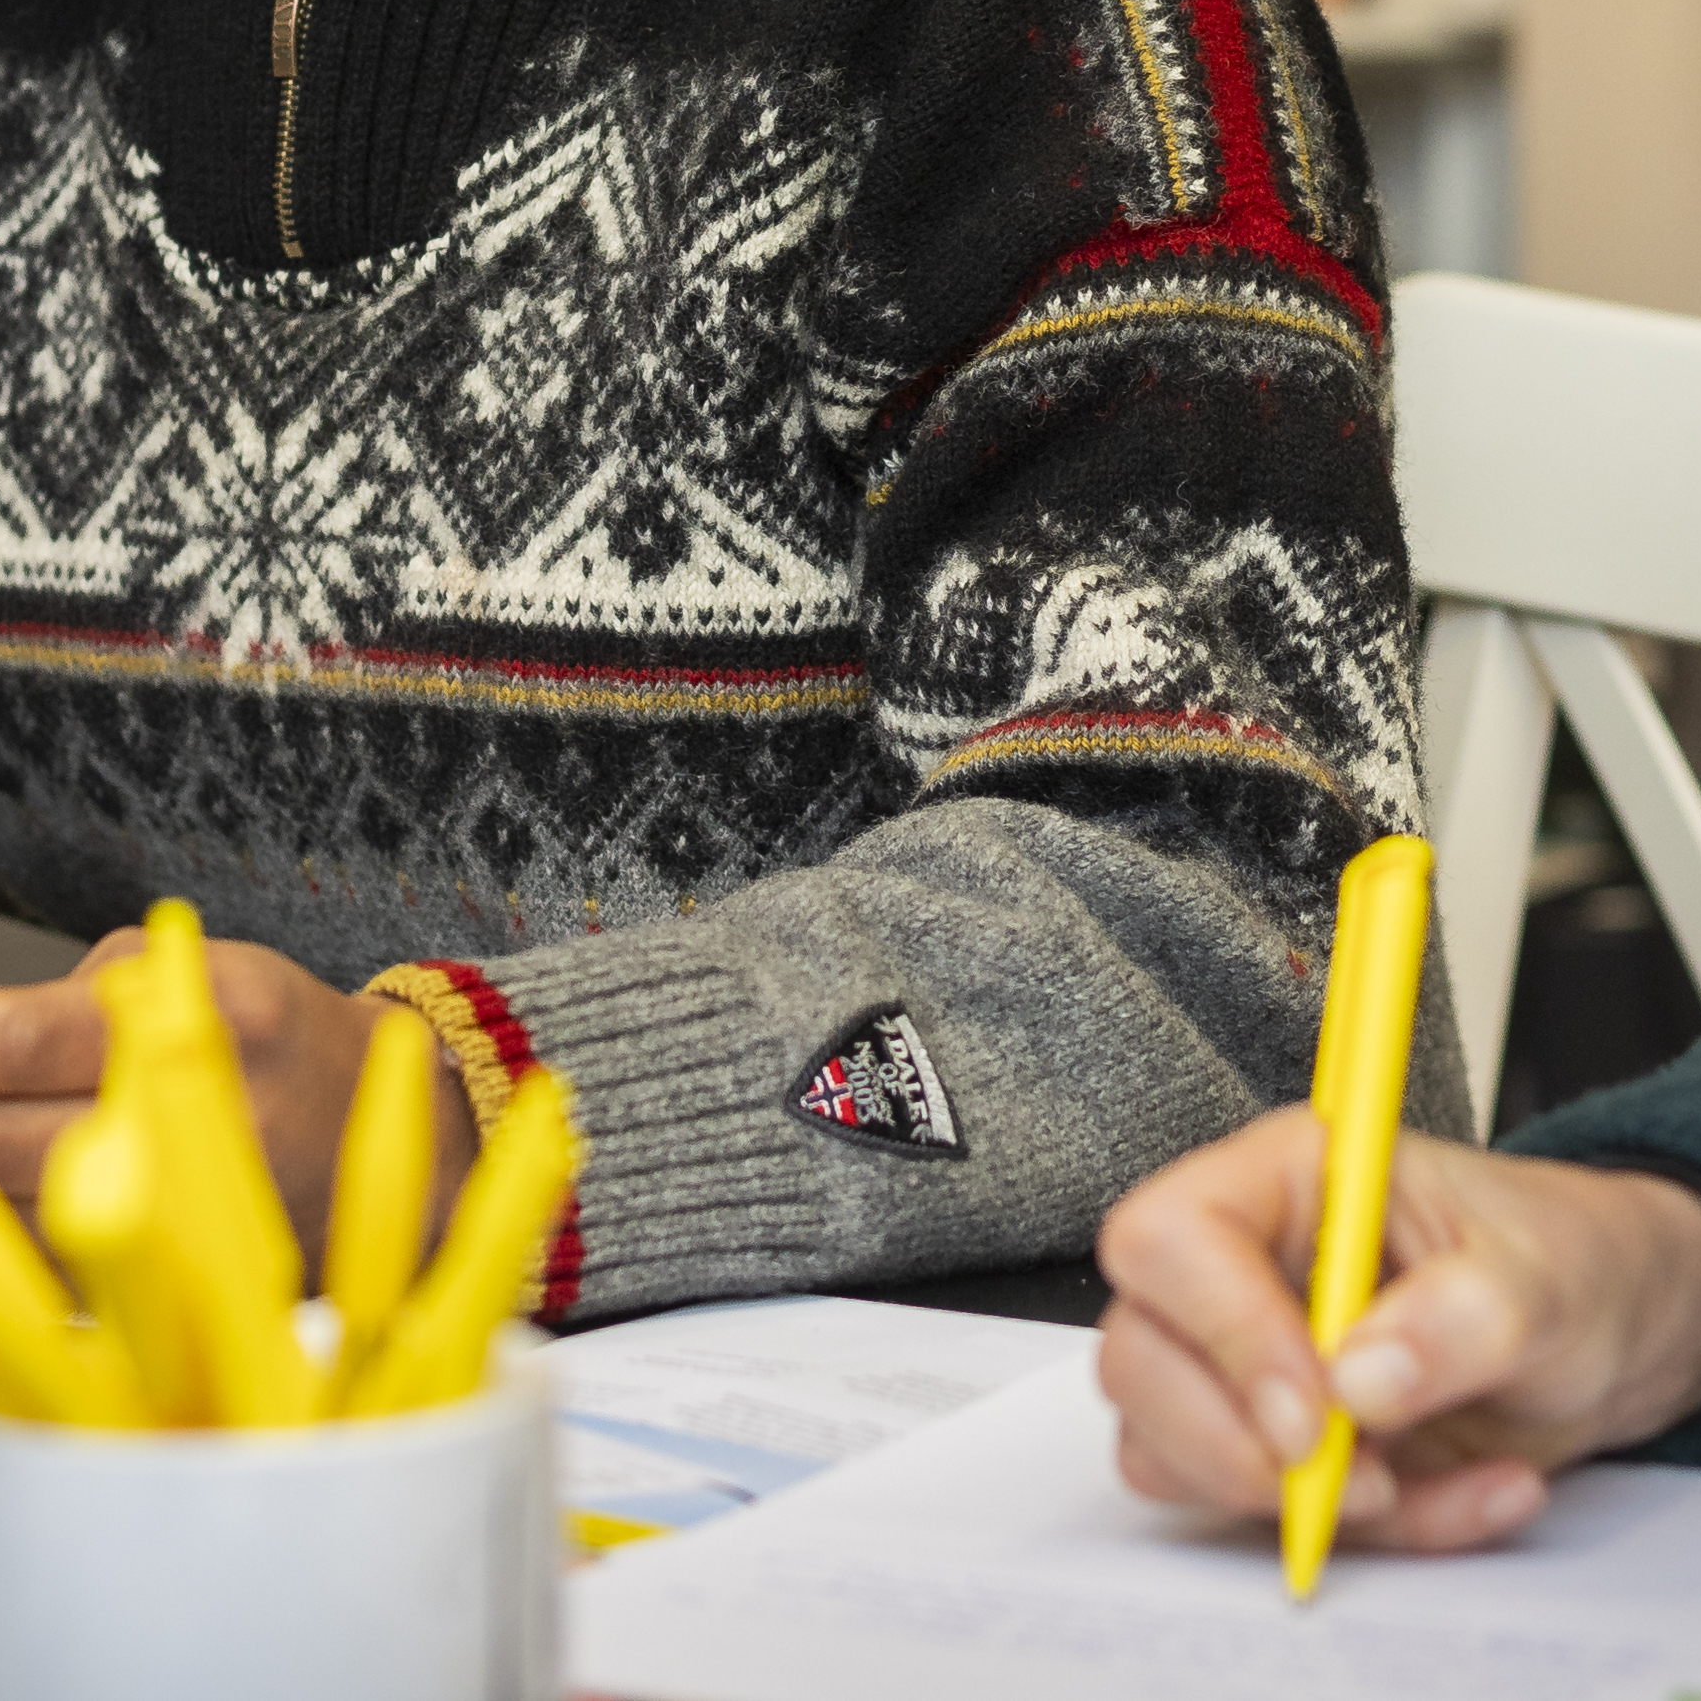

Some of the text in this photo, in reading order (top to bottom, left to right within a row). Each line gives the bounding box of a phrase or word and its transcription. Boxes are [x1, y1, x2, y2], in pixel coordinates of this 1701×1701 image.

[839, 1055, 877, 1126] 2003
[878, 1062, 906, 1096] OF
[886, 1038, 929, 1123] DALE
